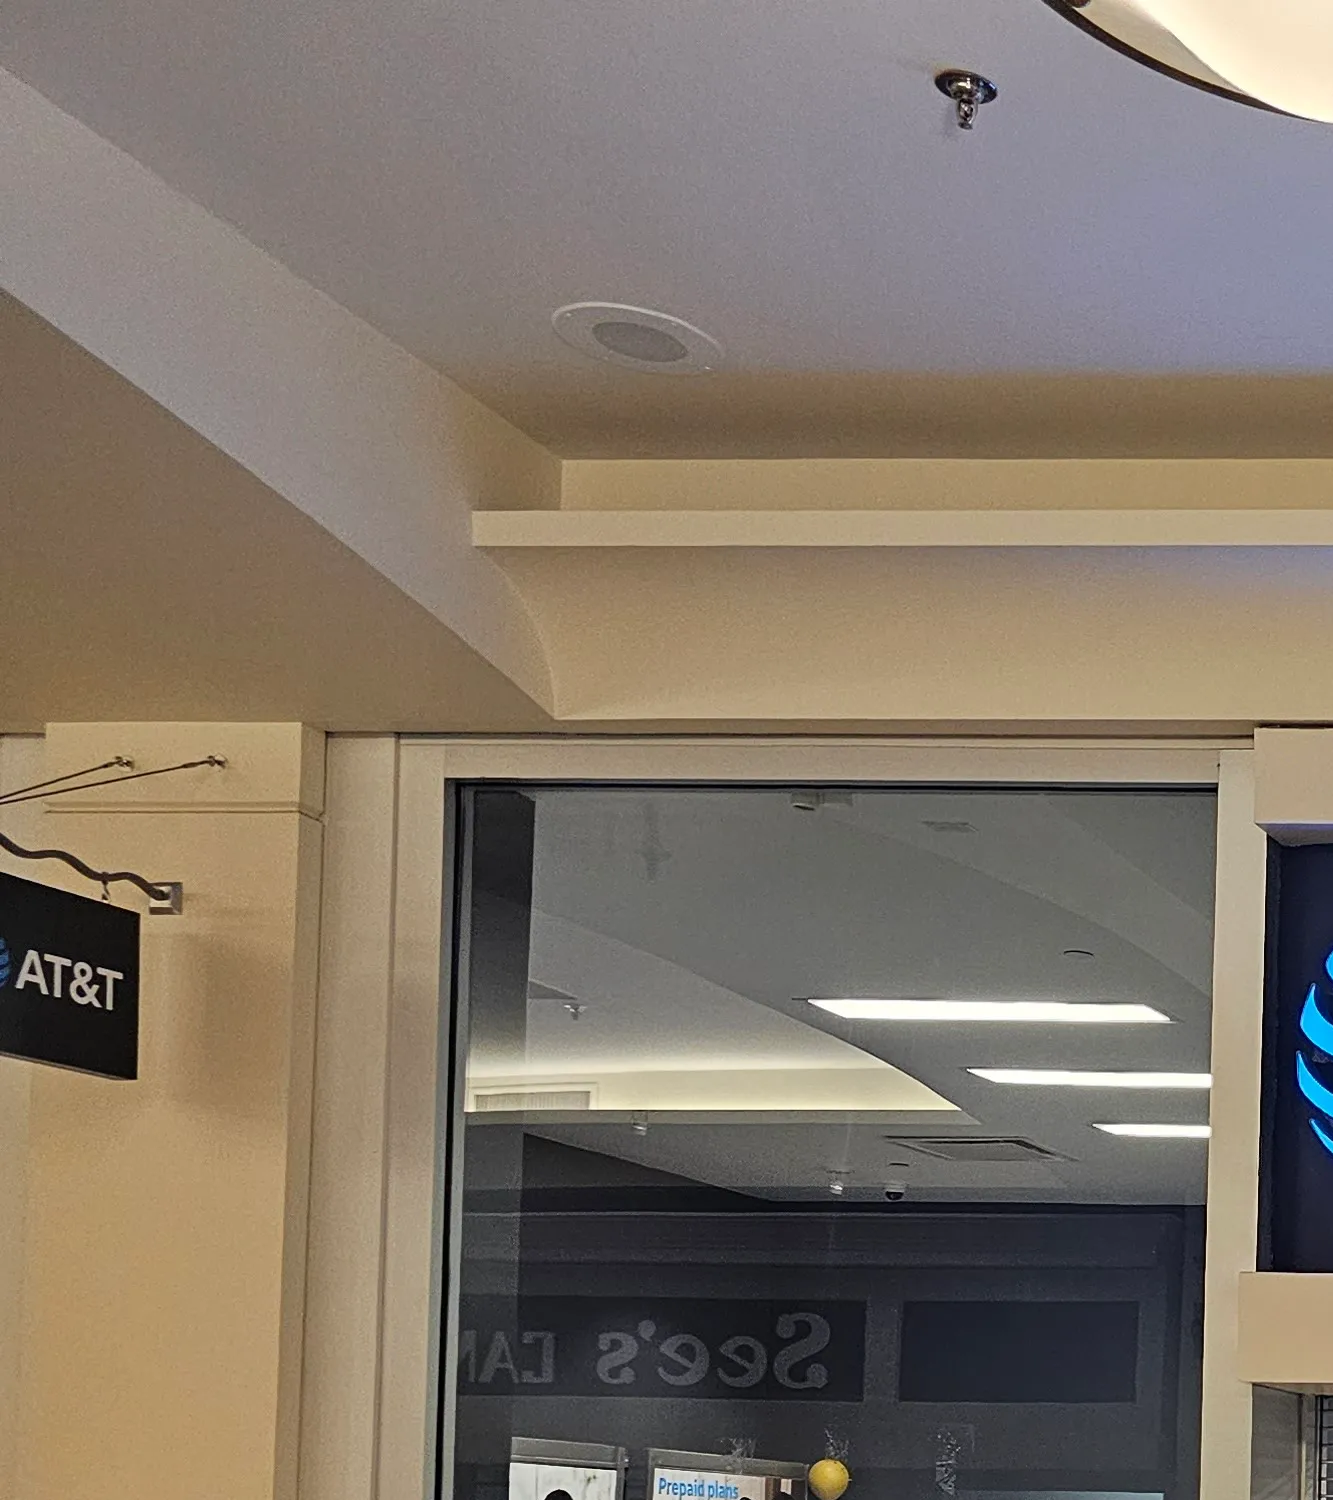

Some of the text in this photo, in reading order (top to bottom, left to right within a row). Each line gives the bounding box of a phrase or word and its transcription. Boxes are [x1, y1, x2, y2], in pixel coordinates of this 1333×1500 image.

[15, 949, 124, 1011] AT&T
[658, 1477, 739, 1500] Prepaid plans
